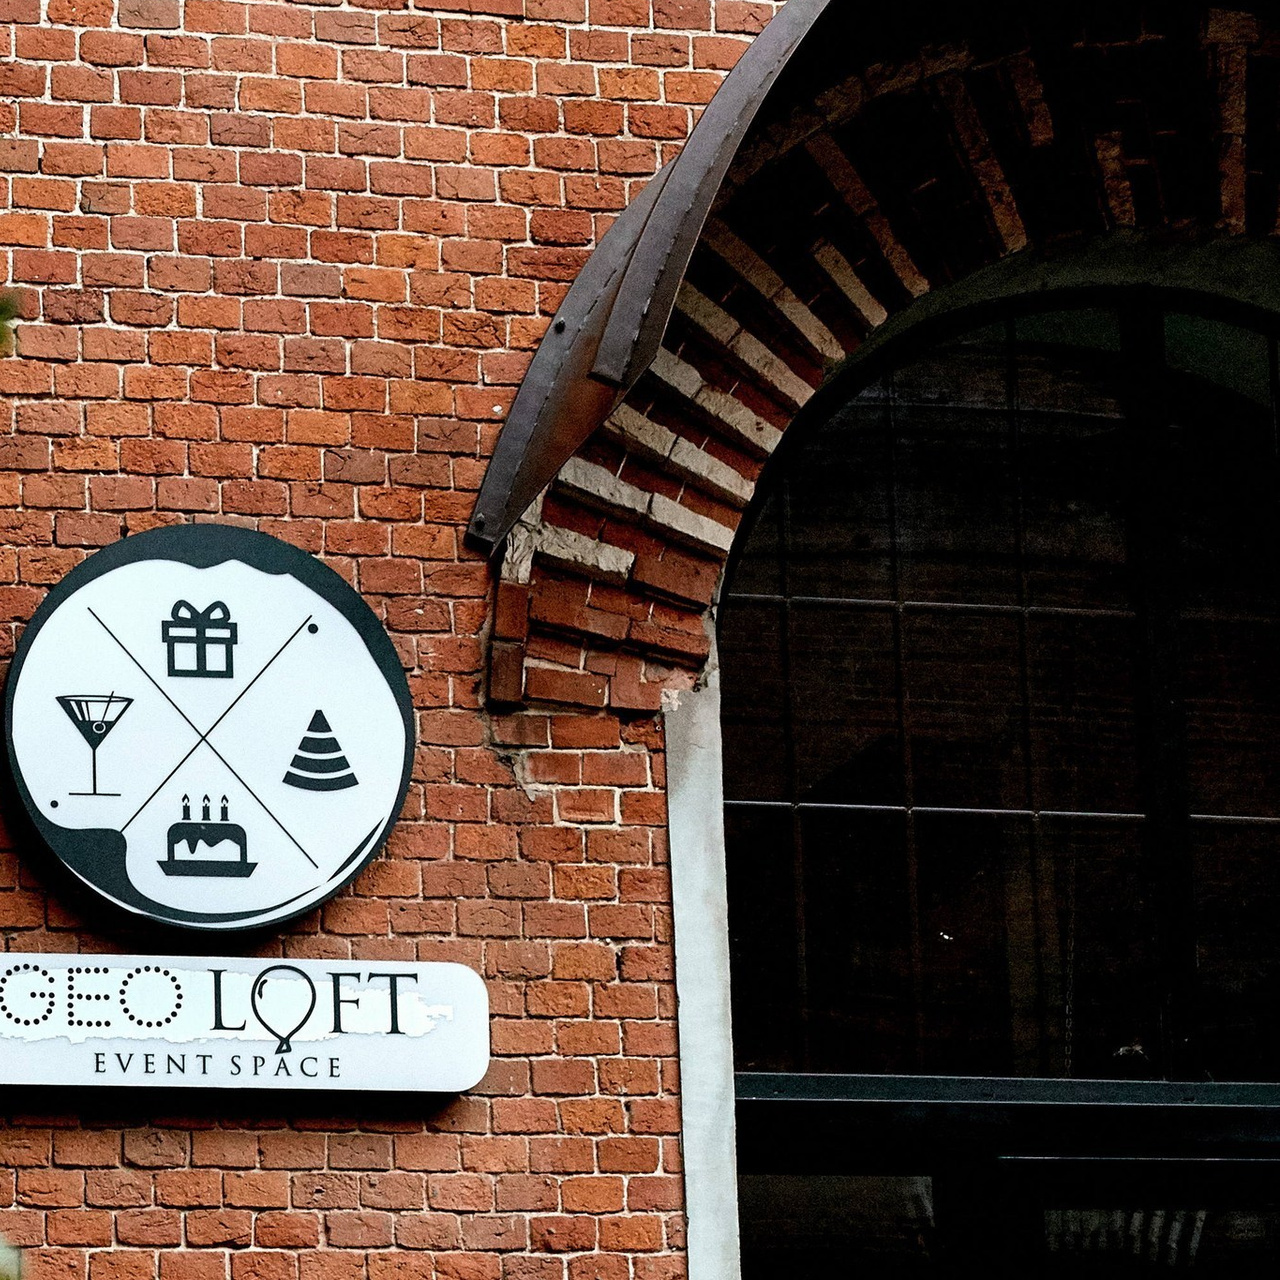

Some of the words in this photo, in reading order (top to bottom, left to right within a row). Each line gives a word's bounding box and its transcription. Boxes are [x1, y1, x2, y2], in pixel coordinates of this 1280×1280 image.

[207, 964, 419, 1054] LOFT
[94, 1052, 214, 1076] EVENT
[230, 1055, 342, 1078] SPACE
